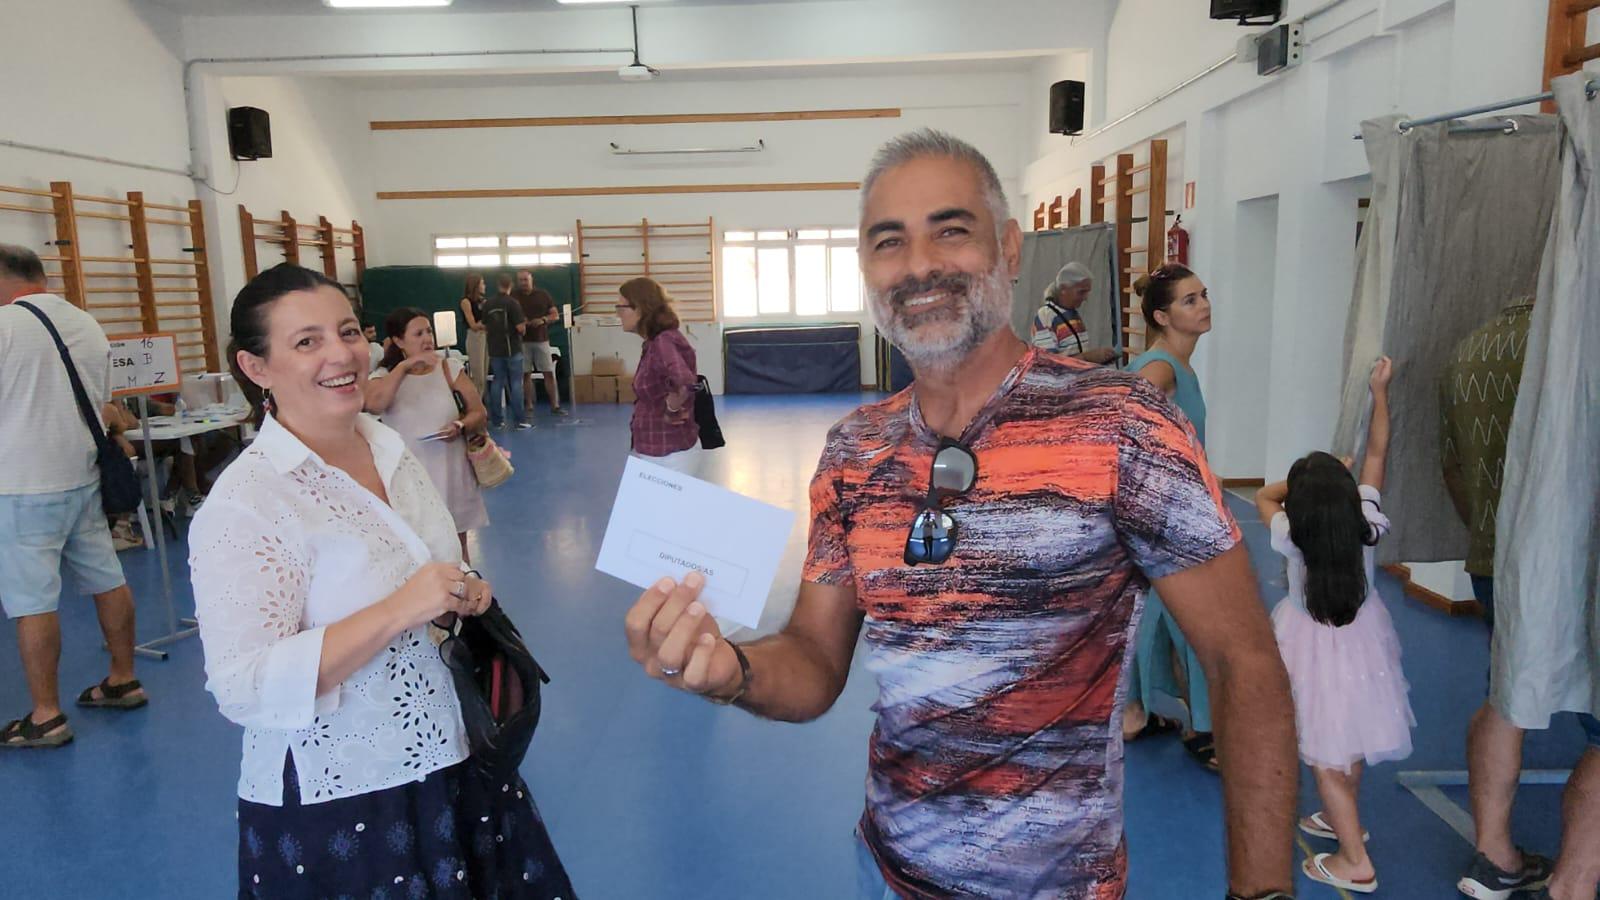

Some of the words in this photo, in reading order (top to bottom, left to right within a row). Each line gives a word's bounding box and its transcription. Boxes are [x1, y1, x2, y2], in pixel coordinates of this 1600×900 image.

[140, 337, 153, 349] 16
[112, 357, 135, 368] ESA
[127, 375, 137, 388] M
[154, 371, 165, 384] Z
[639, 471, 682, 491] ELECCIONES
